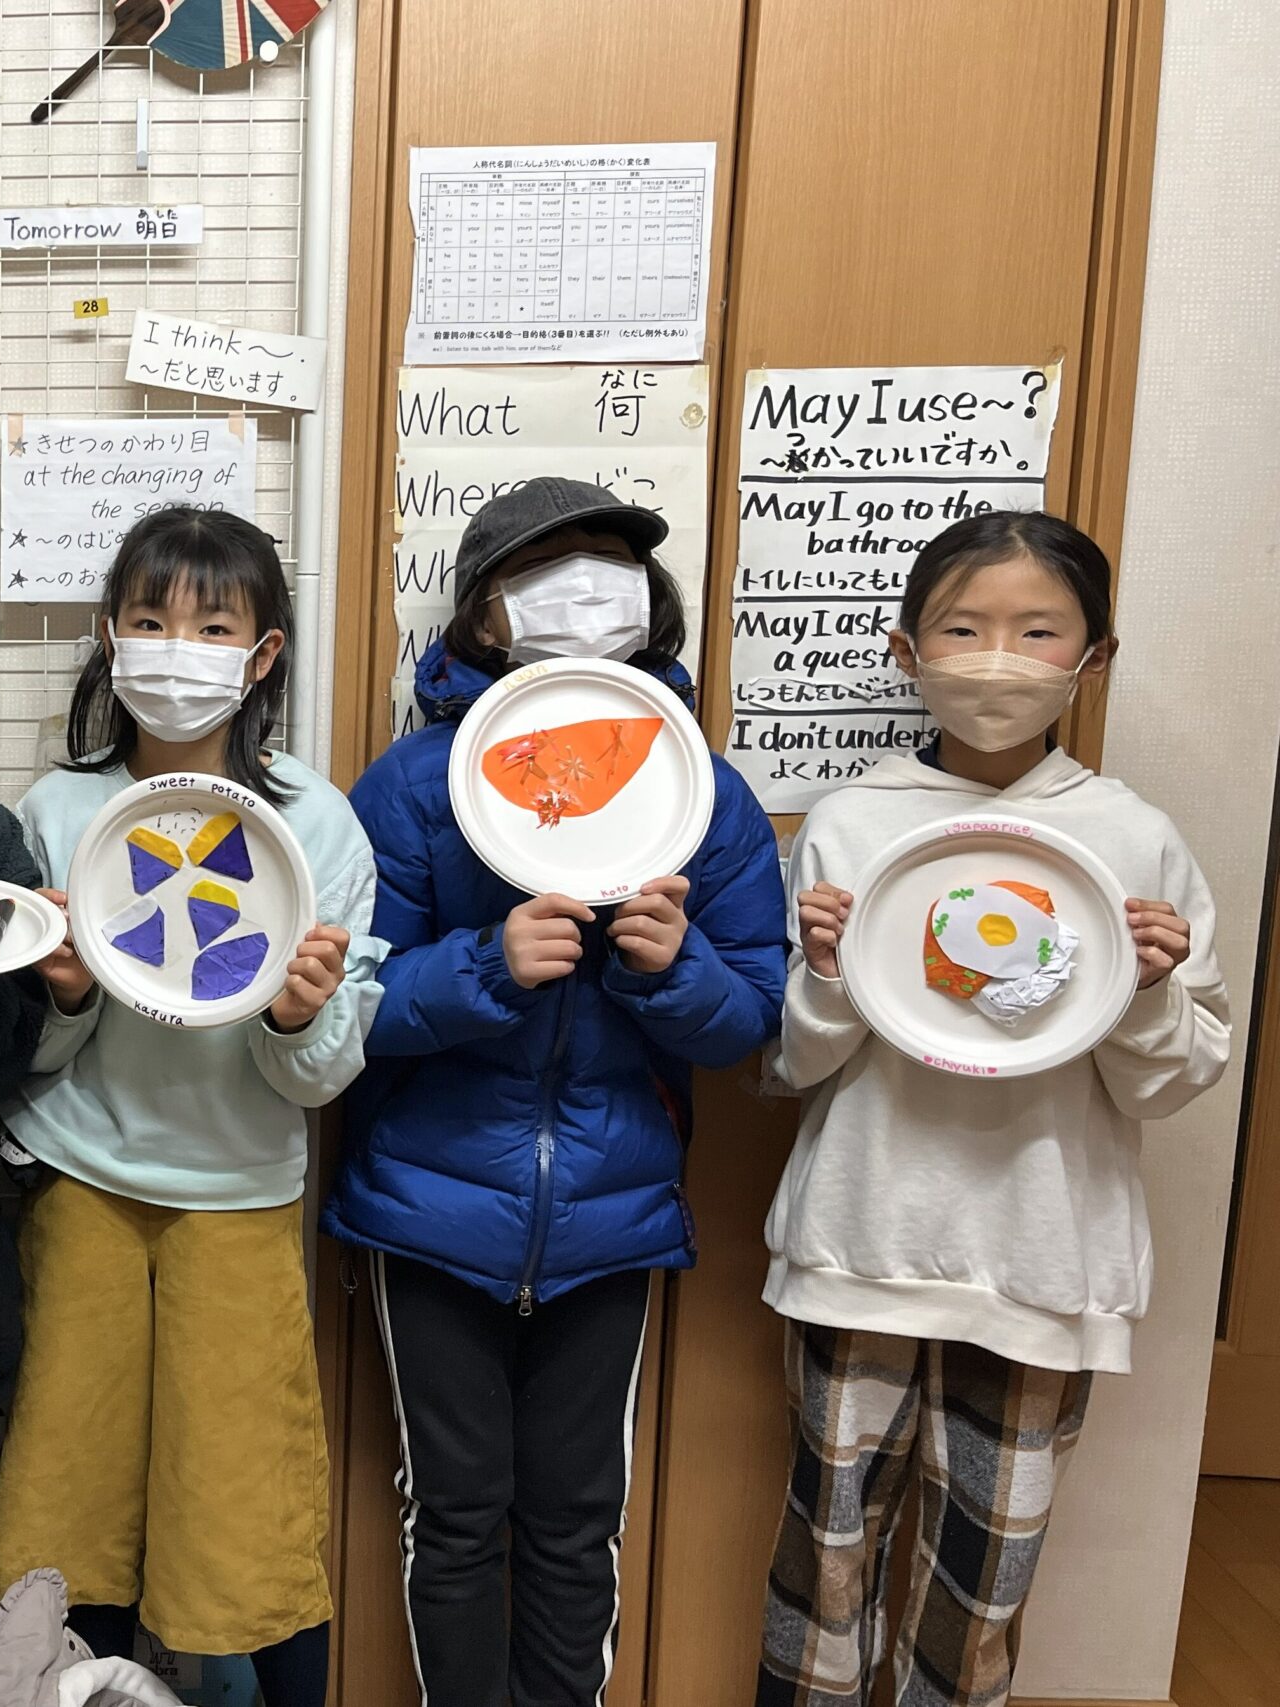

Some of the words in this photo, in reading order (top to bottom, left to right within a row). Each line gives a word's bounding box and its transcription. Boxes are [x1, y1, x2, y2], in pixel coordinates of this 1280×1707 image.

[138, 208, 178, 220] あした
[4, 217, 121, 241] Tomorrow
[136, 220, 176, 240] 明日
[82, 300, 99, 313] 28
[144, 320, 160, 345] I
[601, 369, 658, 388] なに
[399, 387, 520, 438] What
[595, 391, 646, 437] 何
[749, 384, 861, 439] May
[866, 378, 894, 425] I
[37, 430, 209, 453] きせつのかわり目
[24, 465, 50, 487] at
[61, 463, 96, 486] the
[101, 463, 204, 494] changing
[213, 462, 238, 486] of
[91, 498, 122, 518] the
[741, 491, 826, 527] May
[826, 490, 851, 522] I
[857, 500, 894, 528] go
[901, 497, 933, 521] to
[937, 489, 993, 520] the
[807, 530, 929, 556] bathroo
[733, 611, 810, 645] May
[811, 610, 831, 637] I
[835, 605, 893, 637] ask
[773, 650, 795, 672] a
[802, 647, 894, 677] quest
[504, 664, 548, 691] naan
[731, 719, 753, 750] I
[758, 721, 832, 752] don't
[835, 720, 942, 750] unders
[768, 757, 879, 780] よくわか
[211, 782, 256, 808] potato
[934, 1056, 986, 1075] chiyuki
